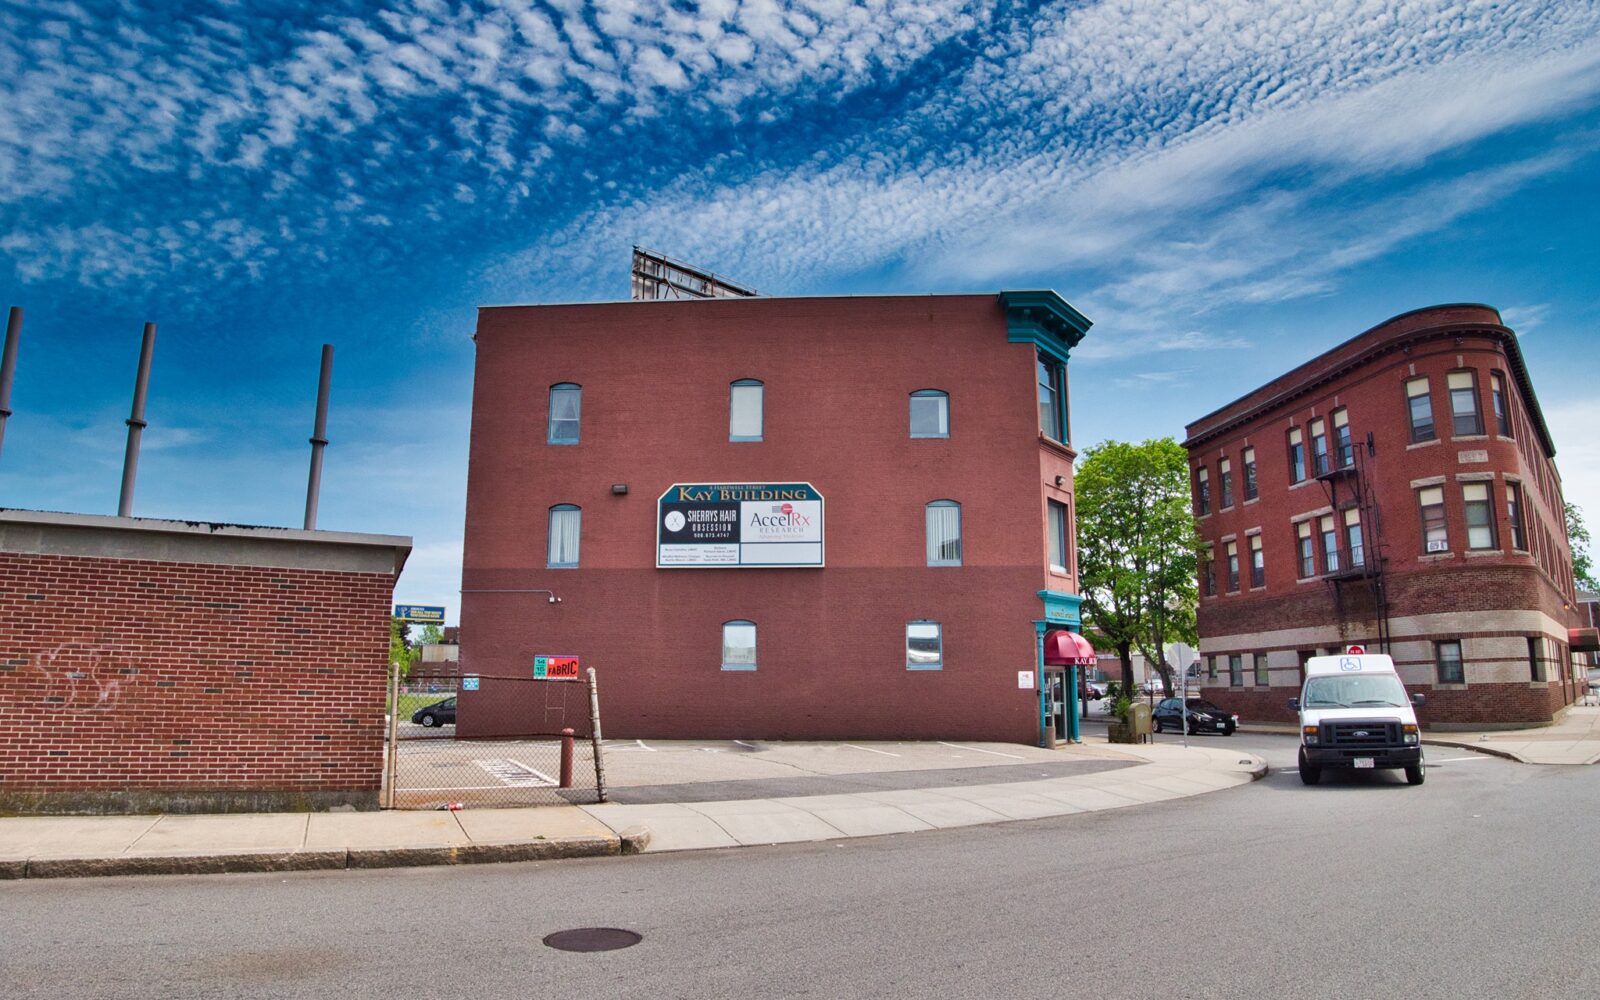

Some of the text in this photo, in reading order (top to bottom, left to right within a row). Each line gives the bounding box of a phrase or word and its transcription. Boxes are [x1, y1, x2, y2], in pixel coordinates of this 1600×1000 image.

[678, 486, 807, 501] KAY BUILDING
[687, 510, 737, 523] SHERRYS HAIR
[750, 511, 810, 527] AccelRx
[692, 523, 732, 532] OBSESSION
[548, 660, 578, 675] FABRIC
[1074, 657, 1087, 665] KAY
